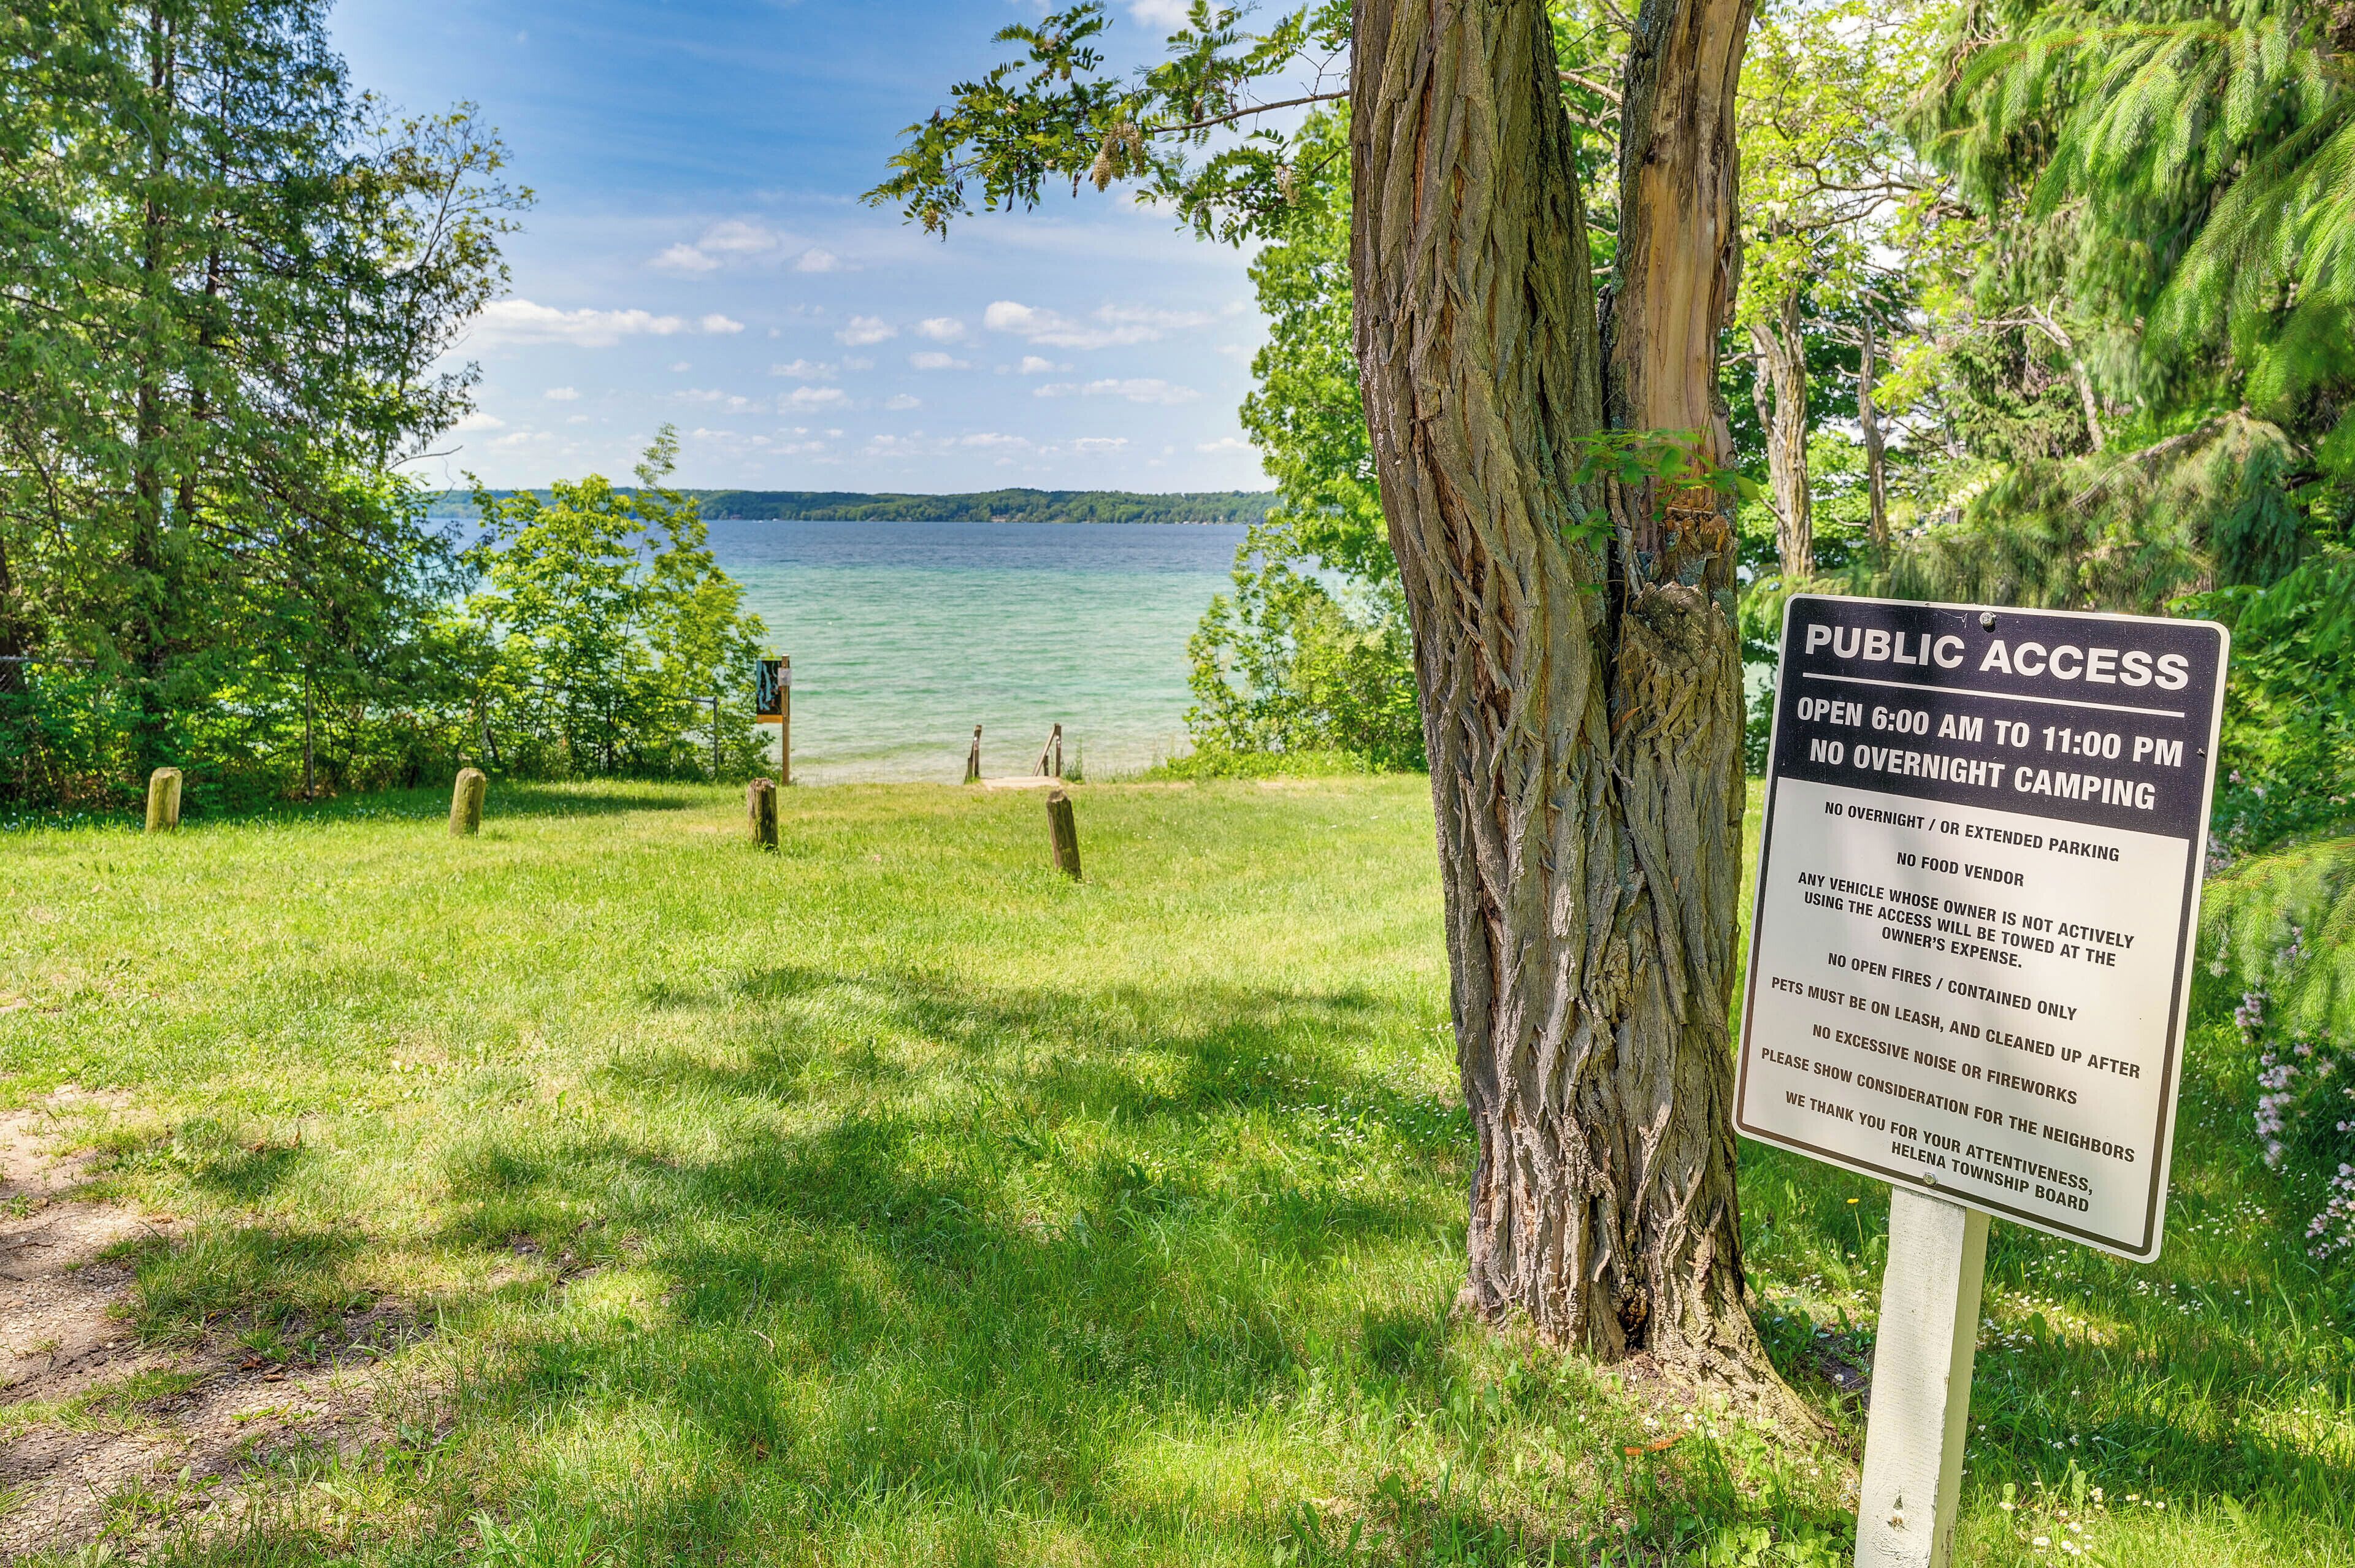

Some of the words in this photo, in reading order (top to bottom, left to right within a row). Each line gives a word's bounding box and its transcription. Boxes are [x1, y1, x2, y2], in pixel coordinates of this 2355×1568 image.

[1805, 624, 1965, 668] PUBLIC
[1978, 639, 2189, 690] ACCESS
[1798, 697, 1863, 727] OPEN
[1872, 706, 1929, 735] 6:00
[1937, 713, 1984, 743] AM
[1994, 719, 2031, 748] TO
[2042, 726, 2121, 759] 11:00
[2132, 735, 2184, 768] PM
[1810, 738, 1844, 765] NO
[1853, 744, 2006, 788] OVERNIGHT
[2014, 766, 2156, 811] CAMPING
[1825, 801, 1843, 816] NO
[1848, 805, 1925, 829] OVERNIGHT
[1928, 819, 1936, 831] /
[1940, 820, 1960, 836] OR
[1965, 824, 2043, 849] EXTENDED
[2048, 838, 2120, 862] PARKING
[1896, 852, 1917, 867] NO
[1921, 856, 1959, 874] FOOD
[1964, 863, 2024, 887] VENDOR
[1798, 871, 1826, 888] ANY
[1829, 877, 1885, 900] VEHICLE
[1889, 889, 1939, 911] WHOSE
[1943, 900, 1996, 922] OWNER
[2002, 911, 2016, 926] IS
[2022, 915, 2053, 933] NOT
[2058, 922, 2135, 949] ACTIVELY
[1804, 891, 1844, 911] USING
[1848, 900, 1874, 917] THE
[1877, 906, 1932, 929] ACCESS
[1937, 917, 1972, 938] WILL
[1977, 926, 1996, 943] BE
[2001, 931, 2054, 954] TOWED
[2059, 944, 2080, 959] AT
[2085, 948, 2116, 967] THE
[1828, 952, 1847, 968] NO
[1851, 958, 1887, 977] OPEN
[1891, 966, 1932, 987] FIRES
[1936, 977, 1943, 990] /
[1948, 980, 2031, 1011] CONTAINED
[2037, 1000, 2077, 1021] ONLY
[1950, 941, 2022, 968] EXPENSE.
[1771, 976, 1804, 995] PETS
[1807, 985, 1845, 1005] MUST
[1849, 995, 1867, 1011] BE
[1871, 1001, 1890, 1017] ON
[1894, 1006, 1944, 1033] LEASH,
[1949, 1020, 1980, 1039] AND
[1986, 1029, 2054, 1057] CLEANED
[2061, 1047, 2082, 1063] UP
[2087, 1054, 2140, 1079] AFTER
[1812, 1023, 1831, 1039] NO
[1835, 1030, 1909, 1061] EXCESSIVE
[1913, 1050, 1956, 1073] NOISE
[1961, 1063, 1982, 1080] OR
[1986, 1069, 2077, 1104] FIREWORKS
[1761, 1047, 1810, 1072] PLEASE
[1813, 1062, 1853, 1083] SHOW
[1857, 1074, 1969, 1116] CONSIDERATION
[1974, 1106, 2003, 1126] FOR
[2008, 1115, 2037, 1136] THE
[2042, 1125, 2135, 1163] NEIGHBORS
[1786, 1090, 1806, 1107] WE
[1810, 1098, 1855, 1122] THANK
[1859, 1112, 1886, 1131] YOU
[1890, 1121, 1918, 1141] FOR
[1923, 1130, 1961, 1153] YOUR
[1965, 1144, 2093, 1196] ATTENTIVENESS,
[1891, 1141, 1946, 1169] HELENA
[1951, 1158, 2029, 1193] TOWNSHIP
[2035, 1184, 2089, 1212] BOARD
